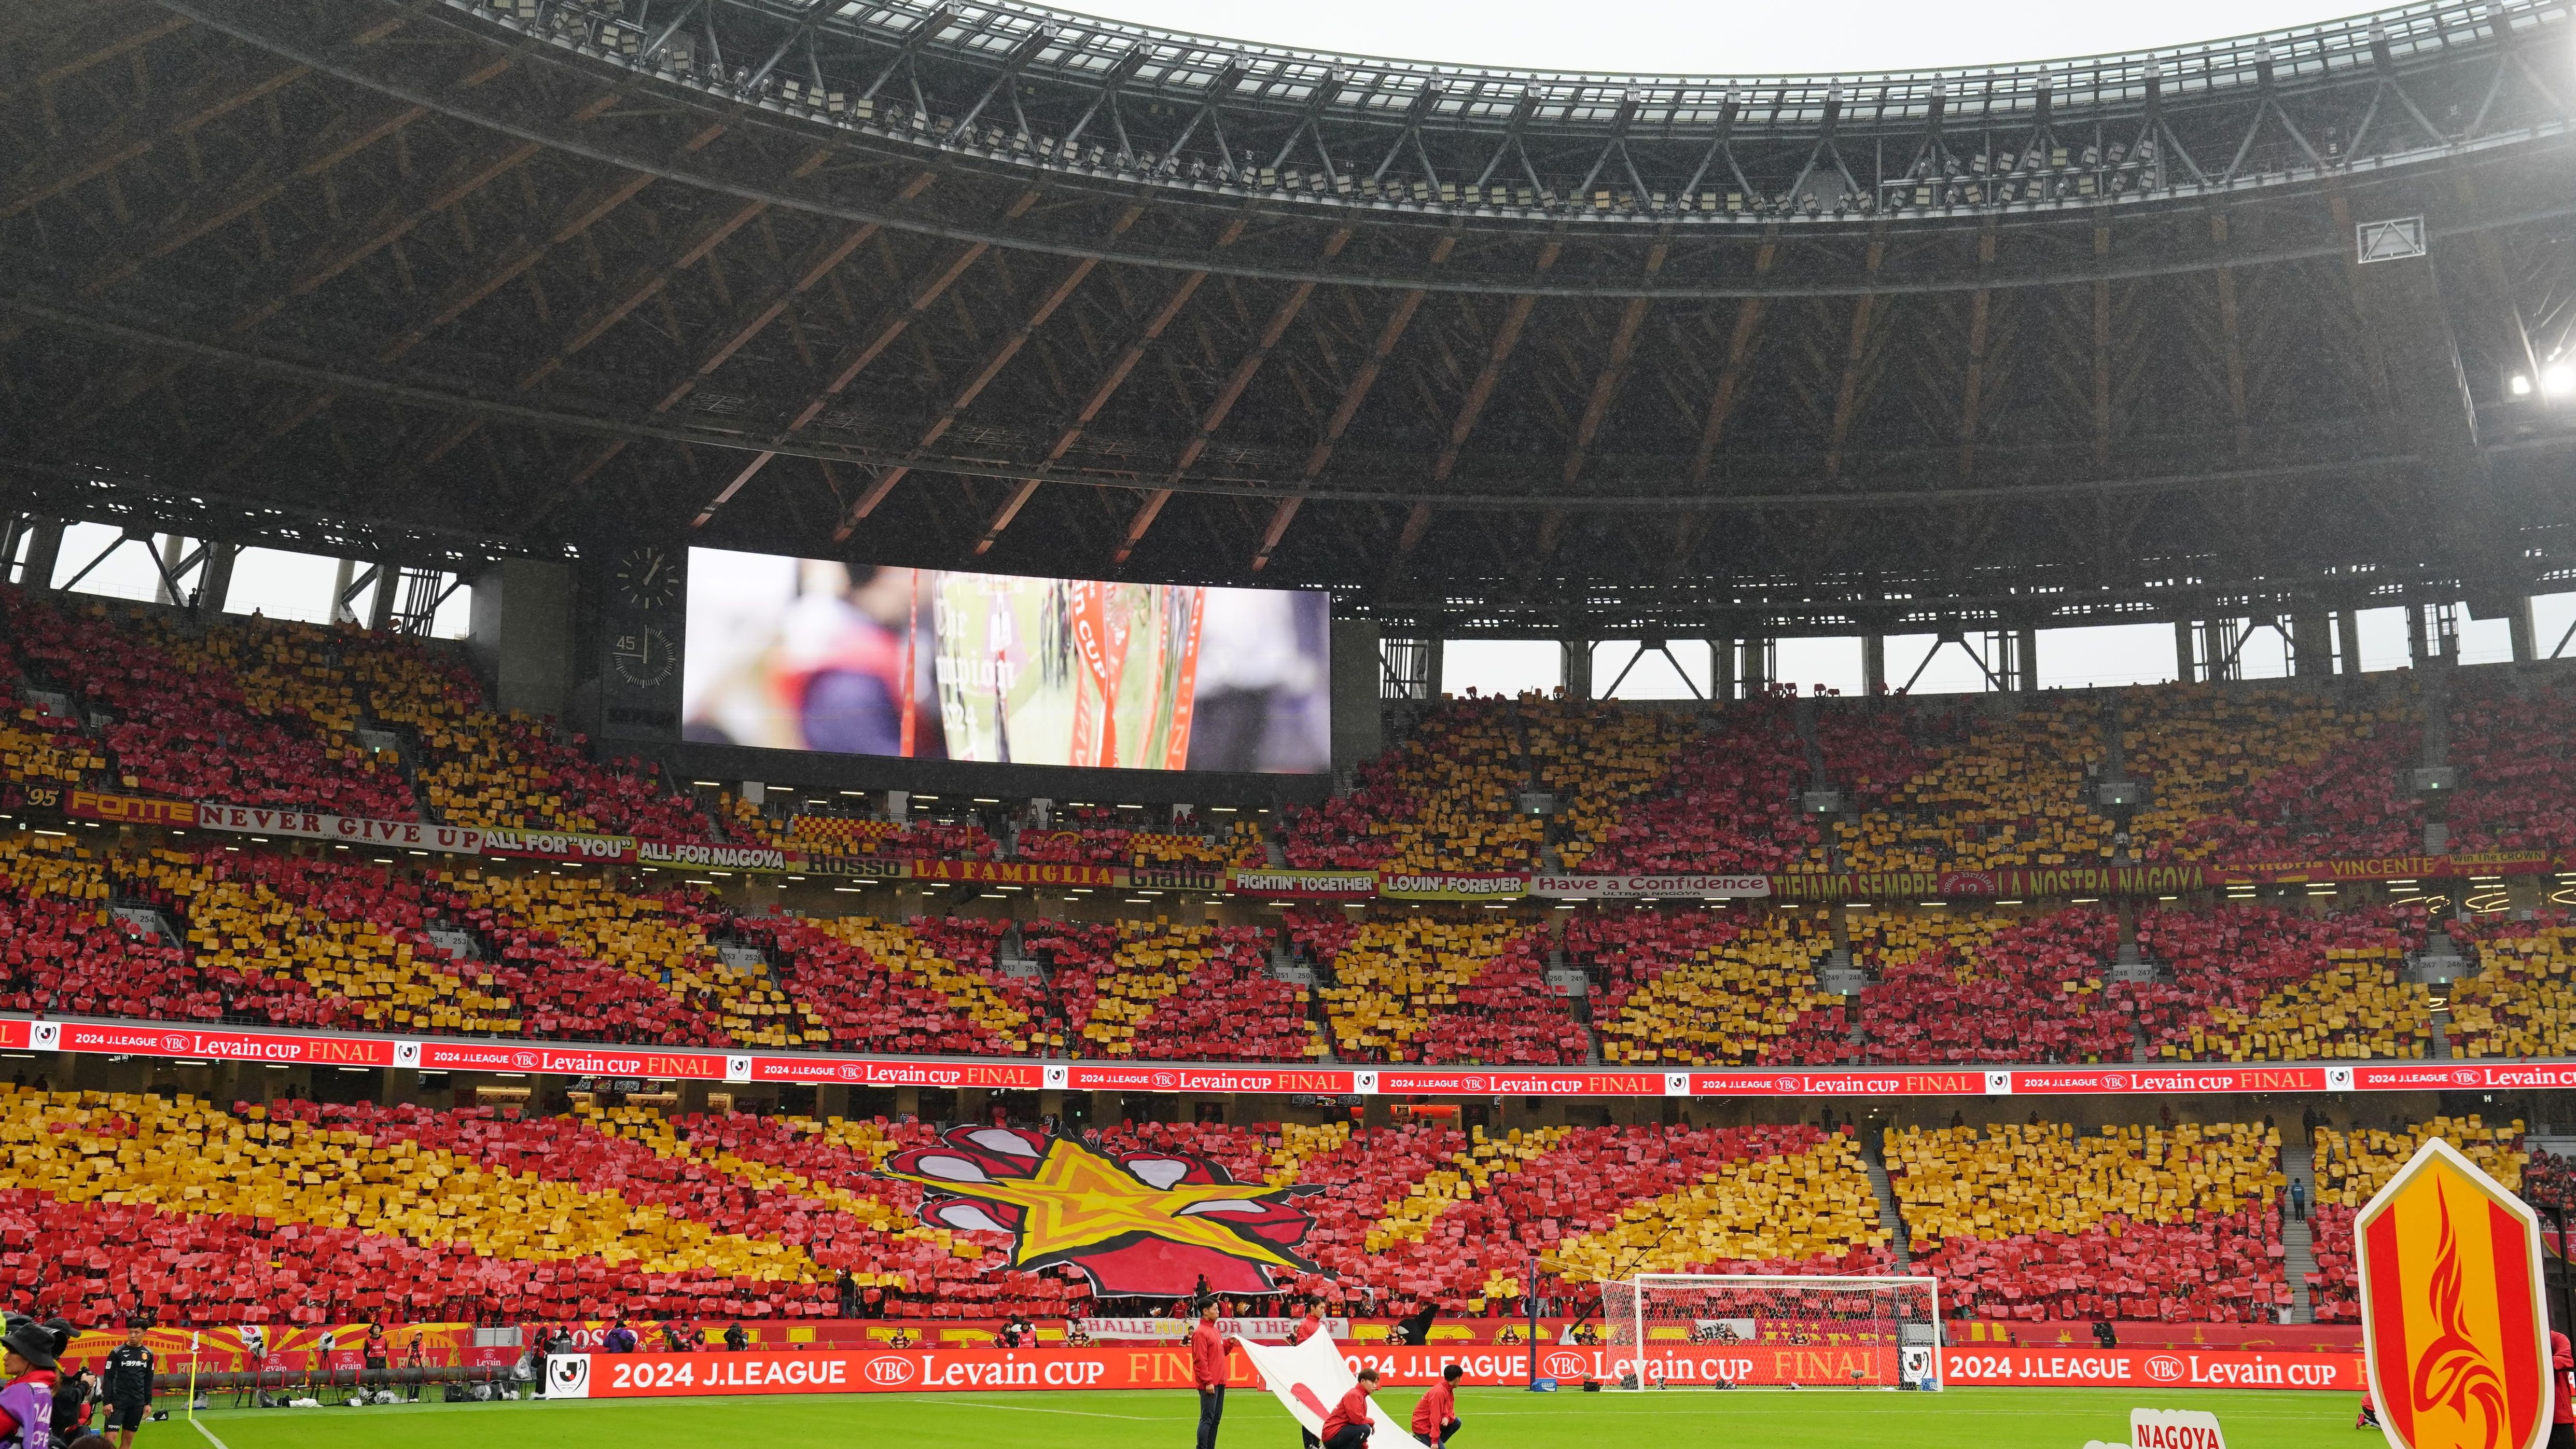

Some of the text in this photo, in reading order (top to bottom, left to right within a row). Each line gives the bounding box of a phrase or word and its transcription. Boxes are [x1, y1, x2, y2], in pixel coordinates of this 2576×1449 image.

[616, 636, 635, 650] 45
[1079, 620, 1105, 678] CUP
[72, 791, 194, 823] FONTE
[202, 806, 479, 848] NEVER GIVE UP
[485, 830, 520, 851] ALL
[525, 833, 568, 854] FOR
[638, 842, 786, 870] ALL FOR NAGOYA
[2453, 854, 2473, 862] Win
[2500, 851, 2543, 861] CROWN
[915, 860, 1113, 885] LA FAMIGLIA
[2332, 857, 2436, 876] VINCENTE
[1236, 873, 1373, 892] FIGHTIN' TOGETHER
[1387, 875, 1522, 894] LOVIN' FOREVER
[1539, 876, 1764, 891] Have a Confidence
[140, 915, 155, 923] 254
[75, 1034, 379, 1061] 2024 J.LEAGUE YBC Levain CUP FINAL
[434, 1052, 713, 1075] 2024 J.LEAGUE YBC Levain CUP FINAL
[764, 1065, 1030, 1084] 2024 J.LEAGUE YBC Levain CUP FINAL
[1155, 1075, 1172, 1085] YBC
[1179, 1073, 1238, 1088] Levain
[1241, 1078, 1271, 1089] CUP
[1278, 1075, 1341, 1089] FINAL
[1466, 1079, 1482, 1089] YBC
[1489, 1076, 1548, 1091] Levain
[1551, 1081, 1582, 1092] CUP
[1589, 1078, 1652, 1091] FINAL
[1779, 1080, 1795, 1089] YBC
[1803, 1076, 1864, 1092] Levain
[1867, 1080, 1899, 1092] CUP
[1906, 1077, 1972, 1091] FINAL
[2105, 1077, 2122, 1087] YBC
[2131, 1073, 2195, 1089] Levain
[2198, 1077, 2233, 1089] CUP
[2240, 1072, 2311, 1088] FINAL
[2369, 1068, 2556, 1085] 2024 J.LEAGUE YBC Levain
[1250, 1319, 1291, 1334] THE
[261, 1364, 287, 1372] Levain
[335, 1361, 361, 1370] Levain
[477, 1358, 500, 1367] Levain
[612, 1353, 1249, 1388] 2024 J.LEAGUE YBC Levain CUP FINL
[1345, 1349, 1880, 1380] 024 J.LEAGUE YBC Levain CUP FINAL
[1950, 1356, 2012, 1378] 2024
[2019, 1358, 2131, 1378] J.LEAGUE
[2151, 1360, 2178, 1377] YBC
[2189, 1355, 2284, 1384] Levain
[2288, 1364, 2336, 1385] CUP
[2137, 1424, 2219, 1449] NAGOYA
